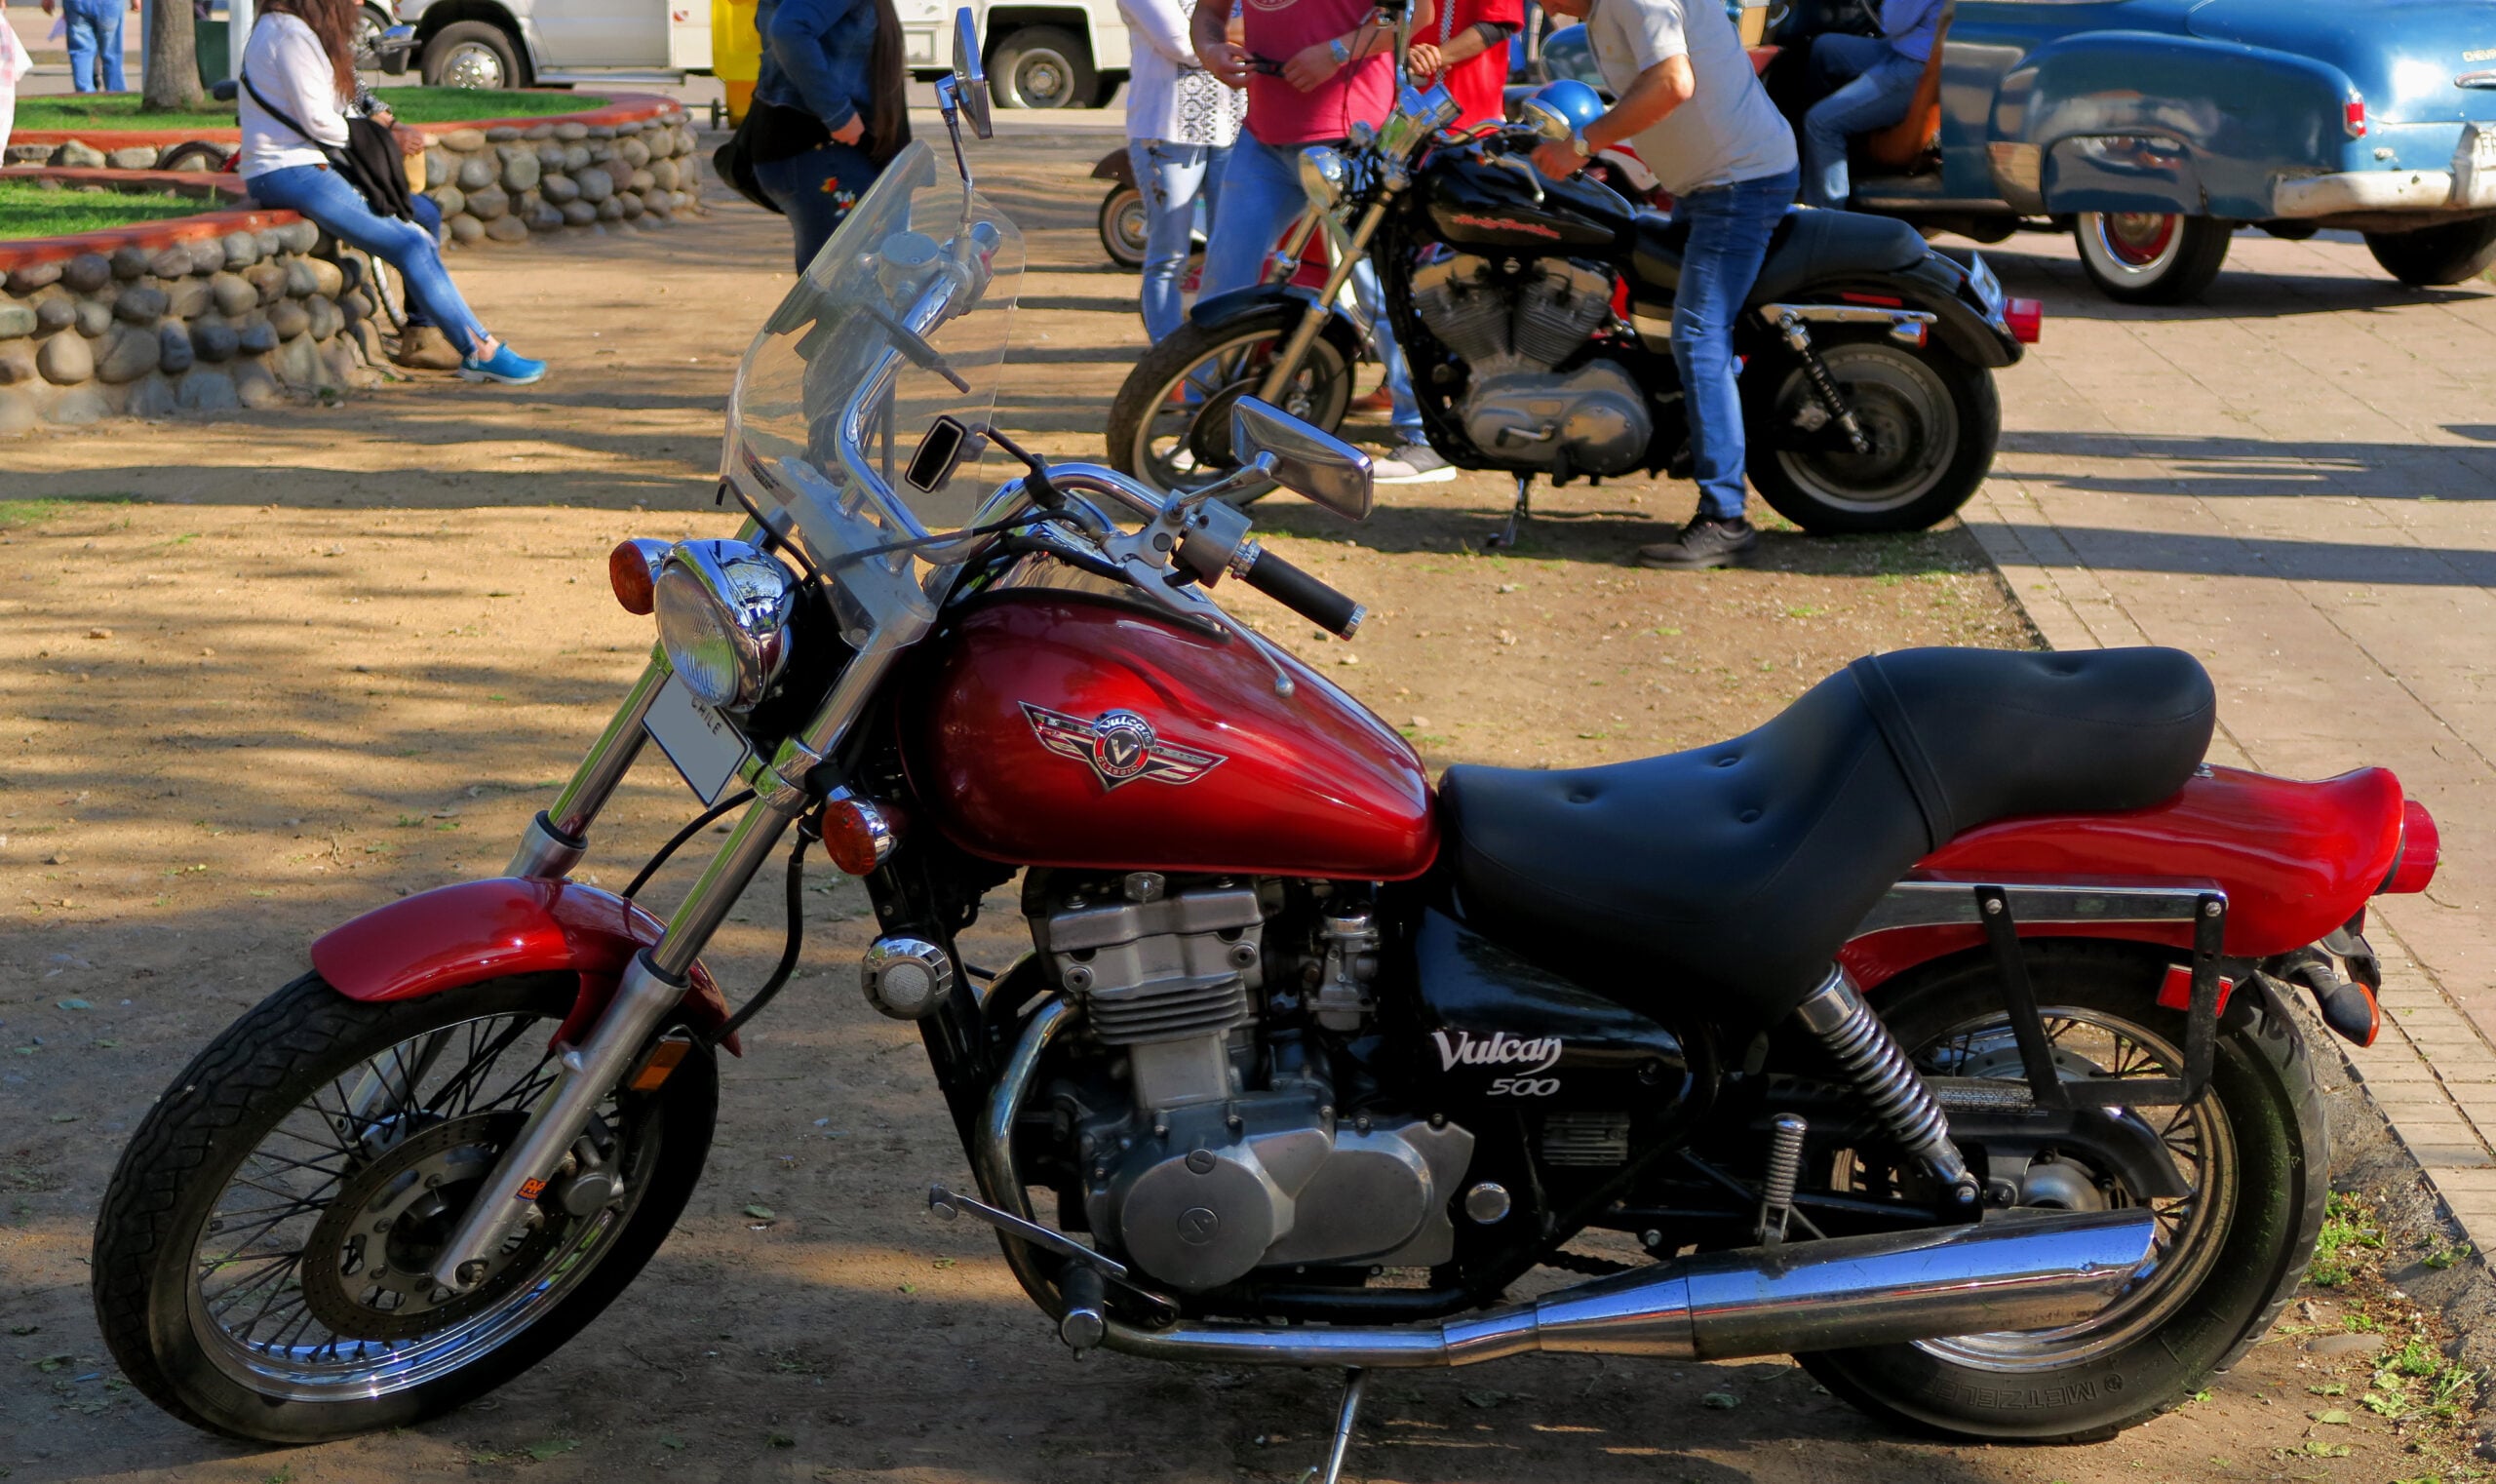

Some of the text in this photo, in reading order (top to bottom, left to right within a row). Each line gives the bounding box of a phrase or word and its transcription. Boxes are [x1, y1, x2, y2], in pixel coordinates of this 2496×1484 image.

[690, 696, 722, 736] CHILE
[1110, 737, 1139, 764] V
[1097, 756, 1139, 776] CLASSIC
[1431, 1031, 1563, 1077] Vulcan
[1486, 1077, 1561, 1097] 500
